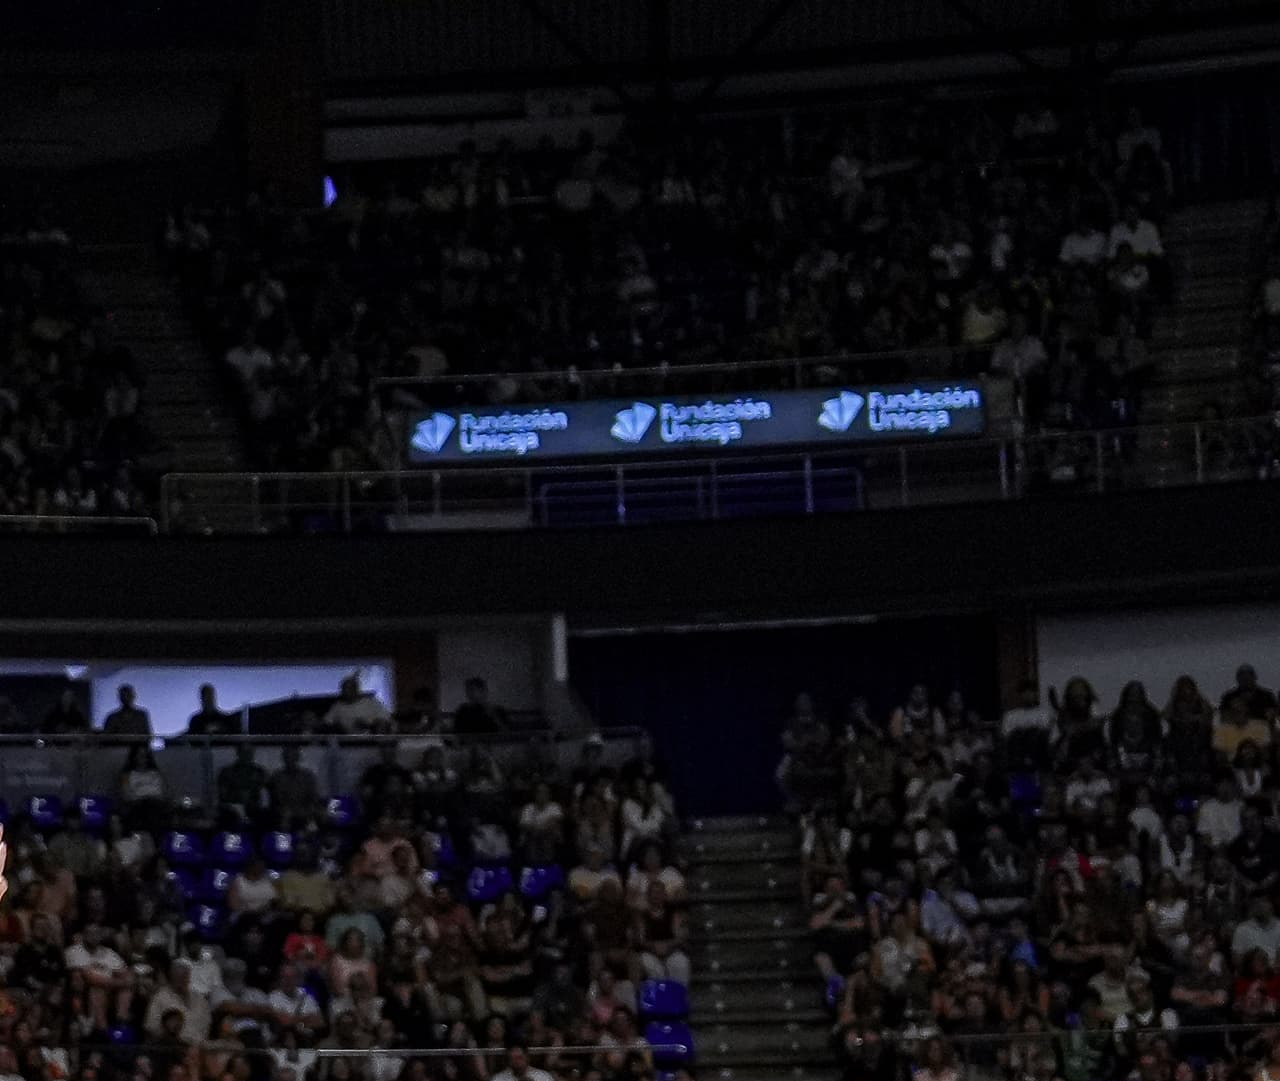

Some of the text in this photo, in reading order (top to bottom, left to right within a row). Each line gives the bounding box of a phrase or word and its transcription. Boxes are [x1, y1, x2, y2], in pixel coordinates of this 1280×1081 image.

[660, 398, 772, 422] Fundación
[868, 386, 980, 411] Fundación
[459, 408, 568, 433] Fundación
[660, 419, 742, 446] Unicaja
[868, 407, 951, 433] Unicaja
[459, 429, 539, 455] Unicaja
